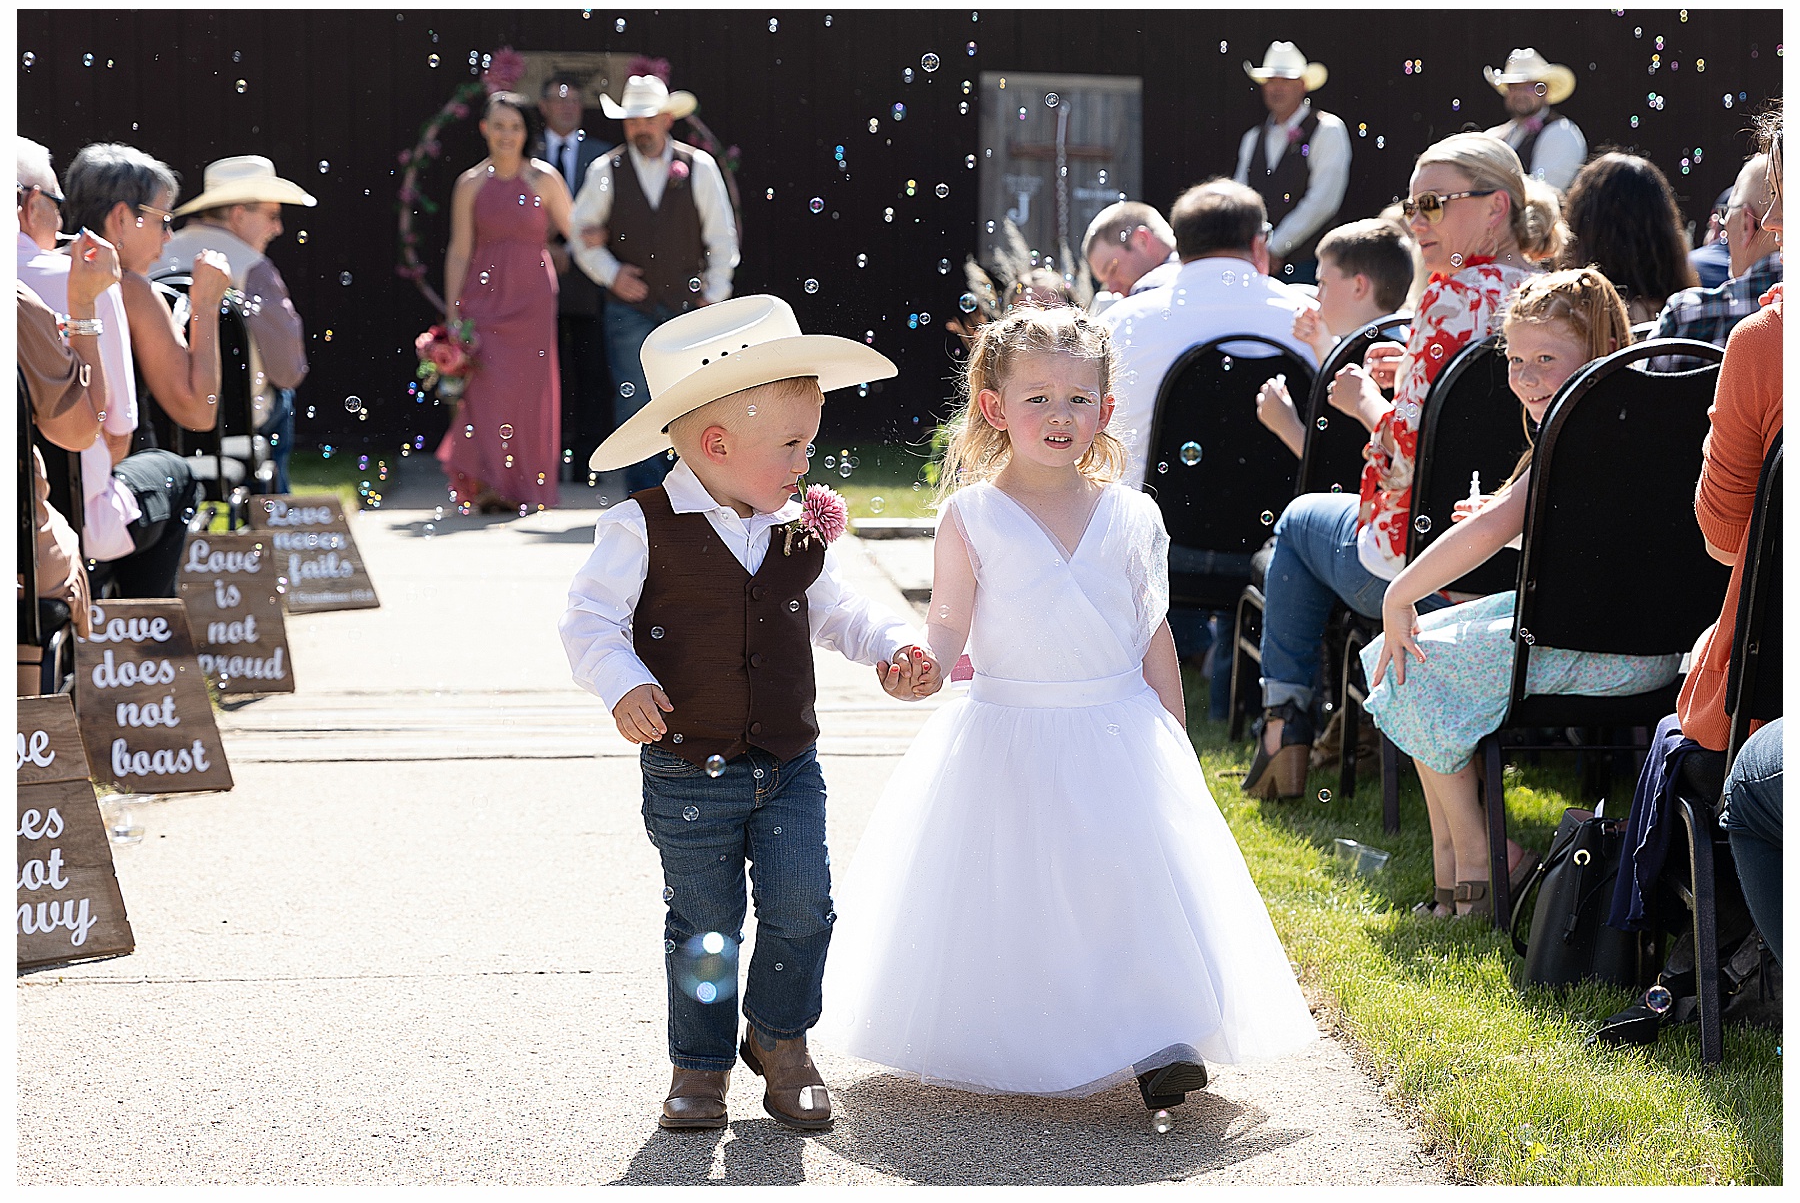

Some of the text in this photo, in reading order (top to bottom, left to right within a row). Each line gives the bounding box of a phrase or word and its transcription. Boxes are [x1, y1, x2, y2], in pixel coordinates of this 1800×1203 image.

[266, 500, 334, 526] Love
[184, 539, 262, 573] Love
[288, 552, 354, 587] fails
[214, 579, 241, 608] is
[77, 605, 172, 643] Love
[207, 614, 260, 644] not
[92, 649, 175, 688] does
[116, 695, 181, 727] not
[111, 738, 211, 777] boast
